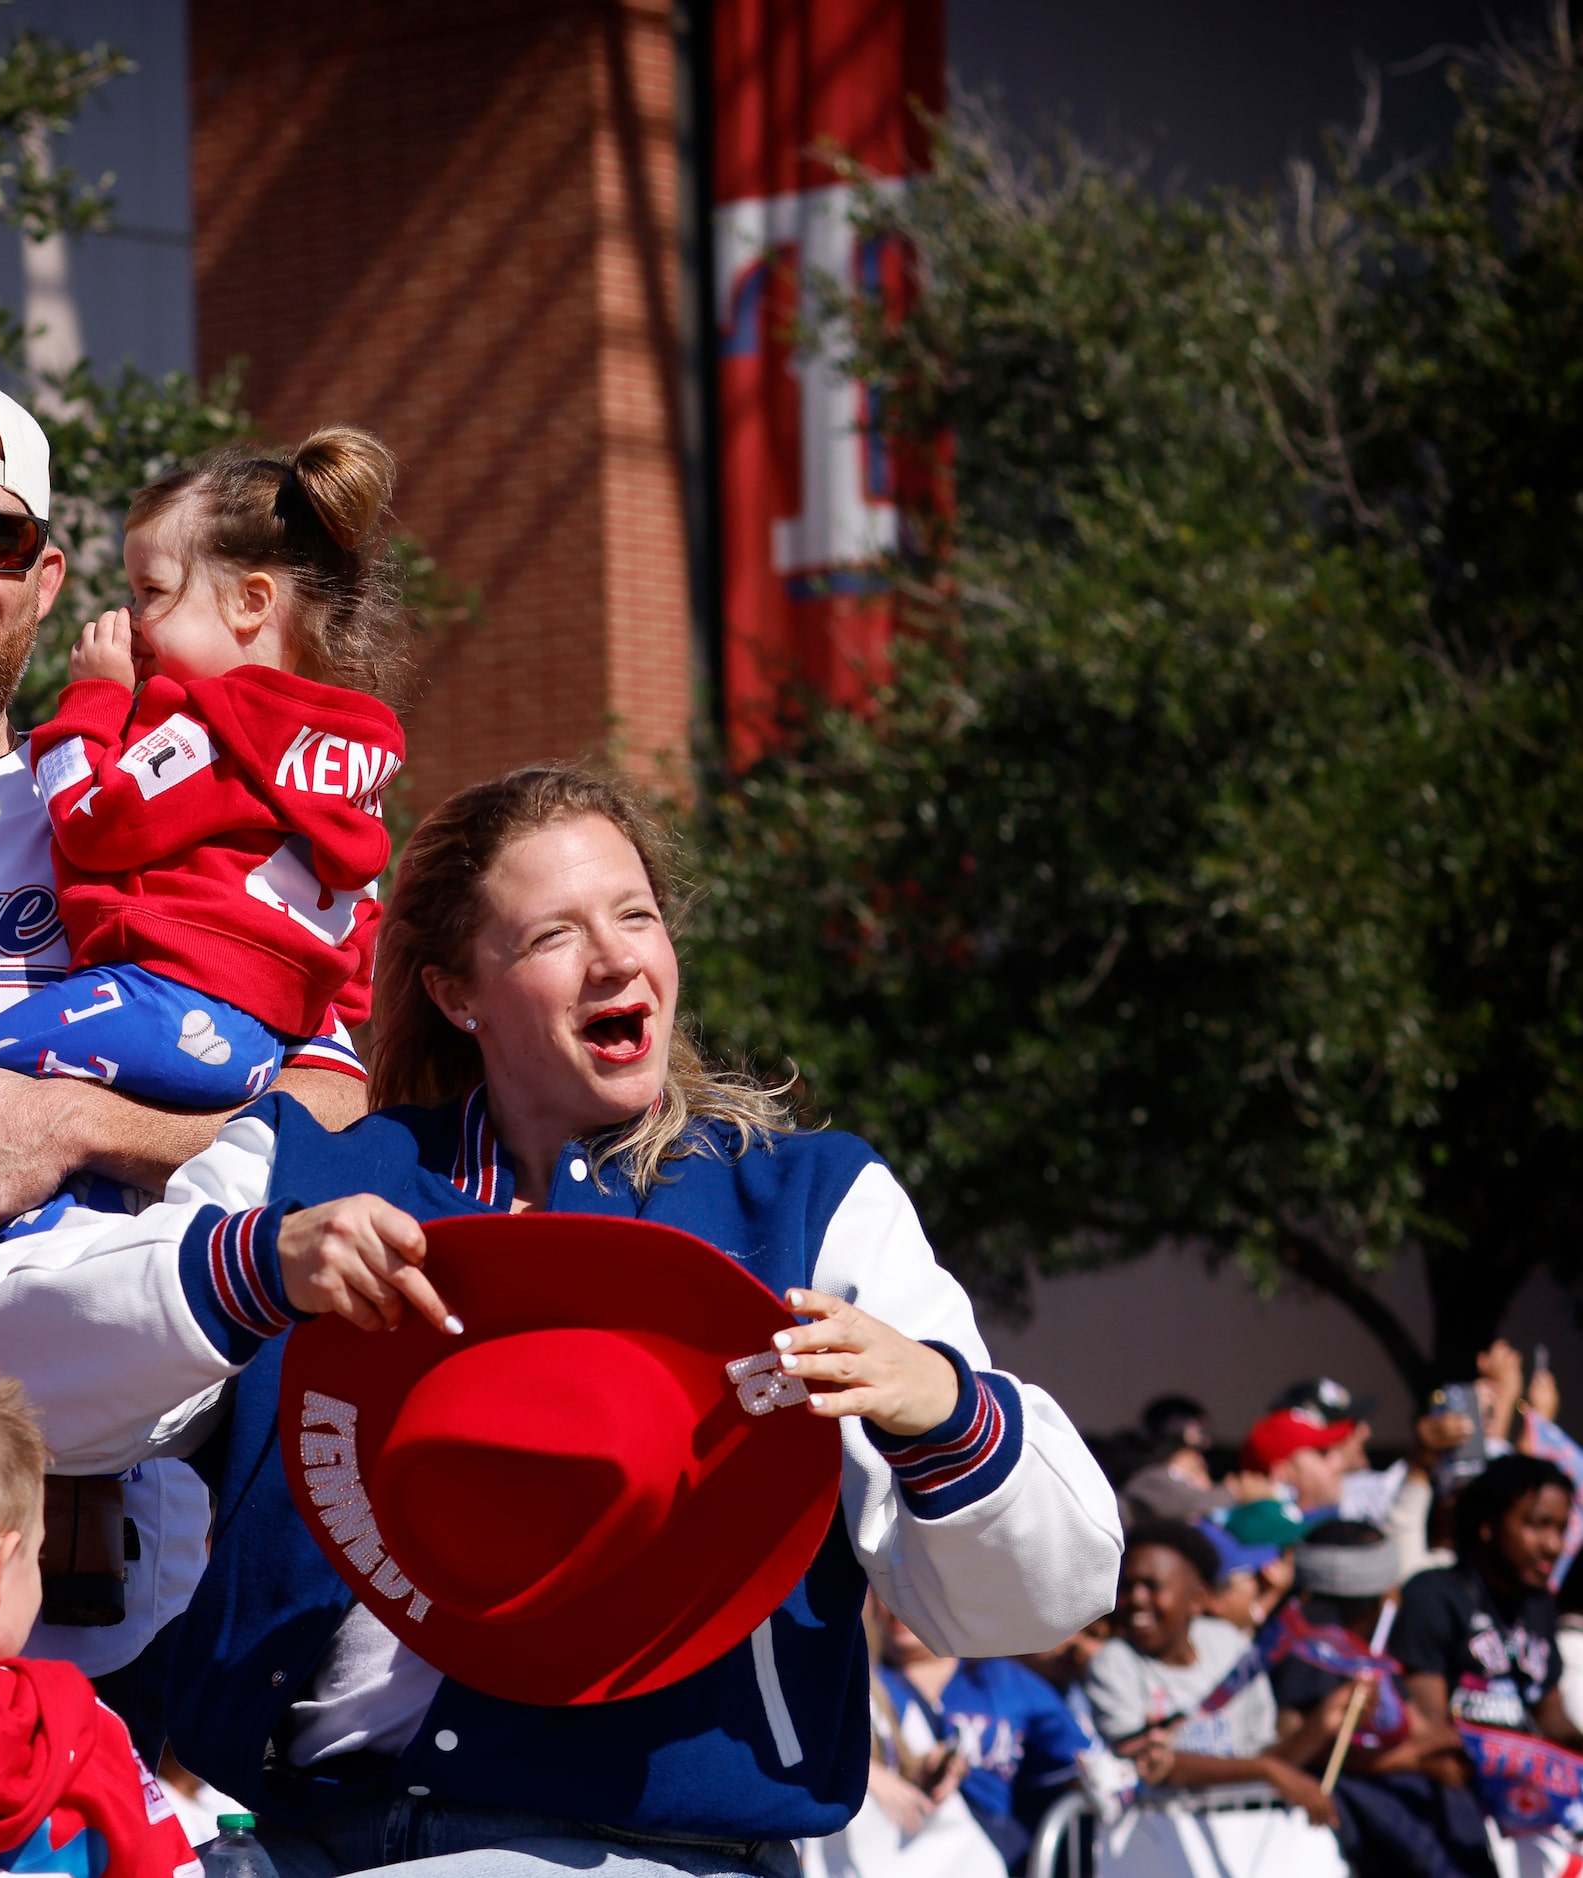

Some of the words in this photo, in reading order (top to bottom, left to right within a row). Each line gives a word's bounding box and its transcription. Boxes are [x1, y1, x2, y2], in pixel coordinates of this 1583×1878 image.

[131, 745, 154, 763] TX
[147, 733, 170, 750] UP
[161, 726, 196, 760] STRAIGHT
[300, 1390, 434, 1624] KENNEDY
